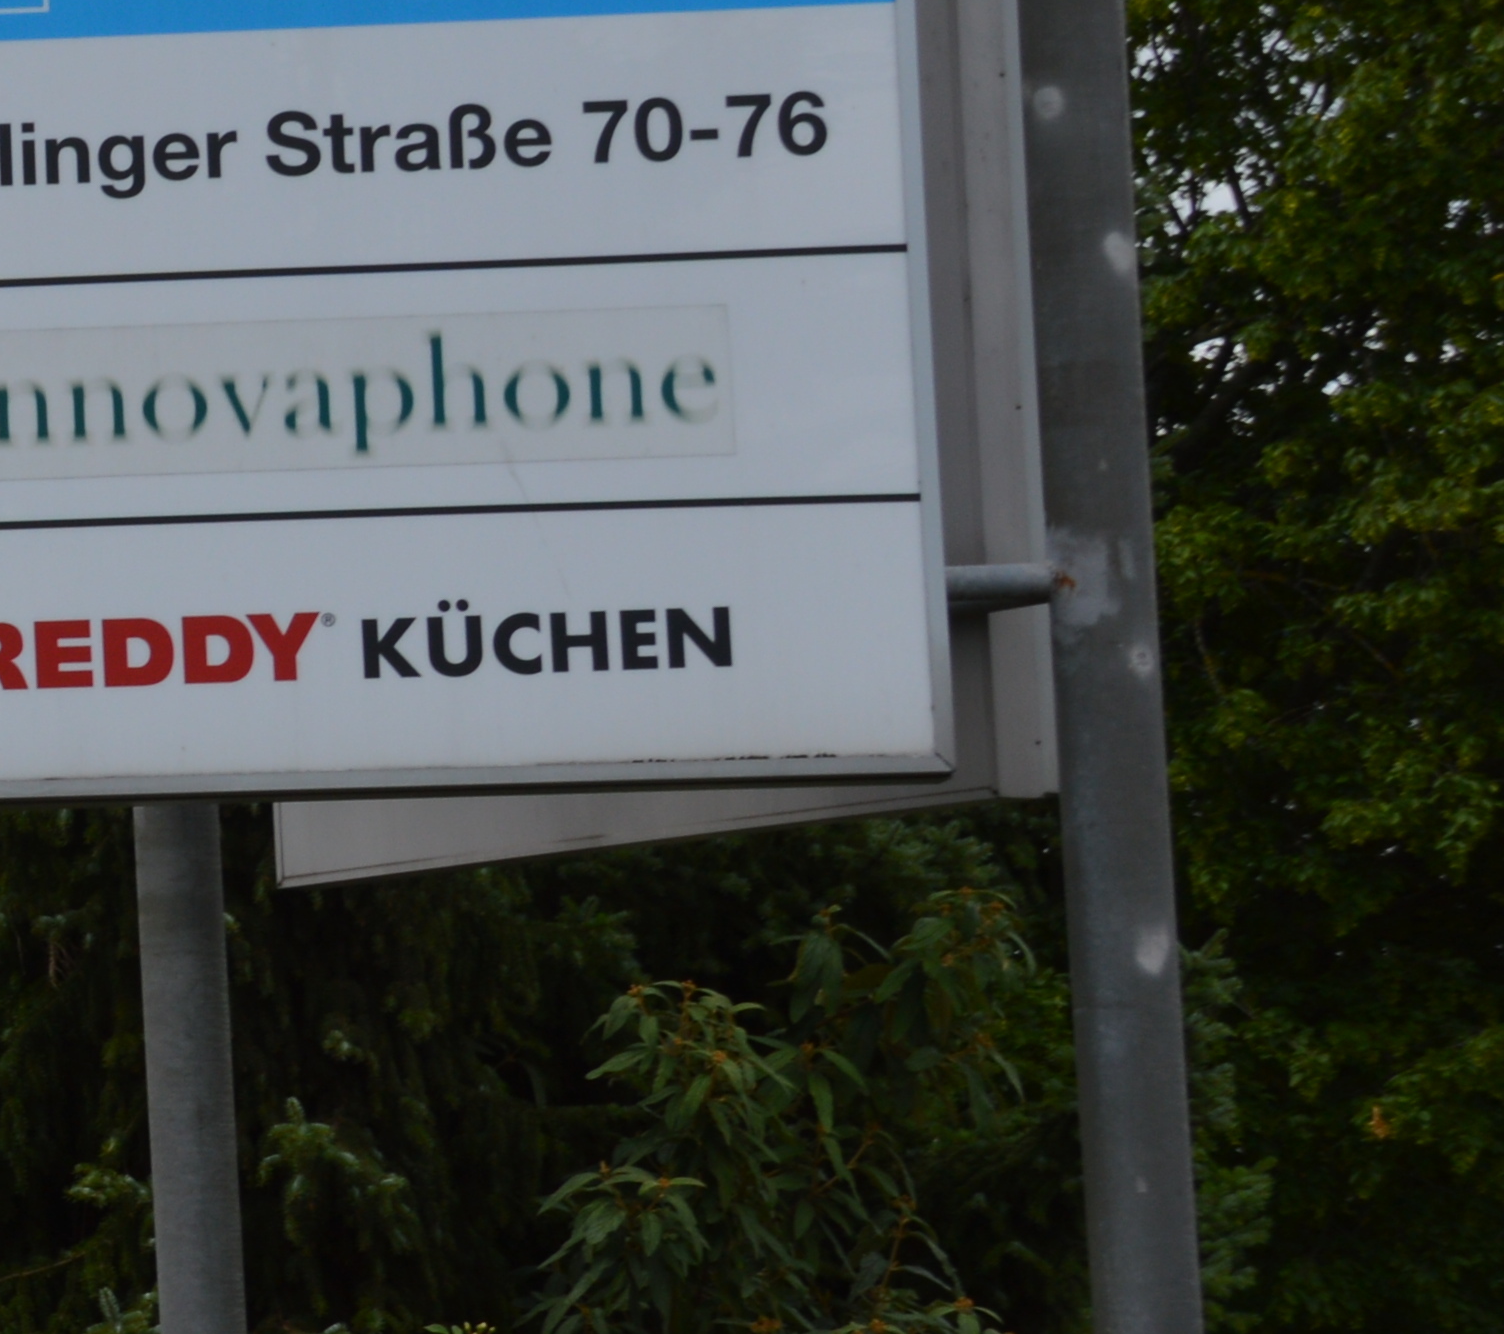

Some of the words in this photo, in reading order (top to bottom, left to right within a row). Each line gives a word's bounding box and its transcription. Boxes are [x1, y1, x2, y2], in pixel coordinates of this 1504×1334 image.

[265, 103, 552, 177] Straße
[582, 89, 829, 164] 70-76
[360, 598, 733, 679] KÜCHEN
